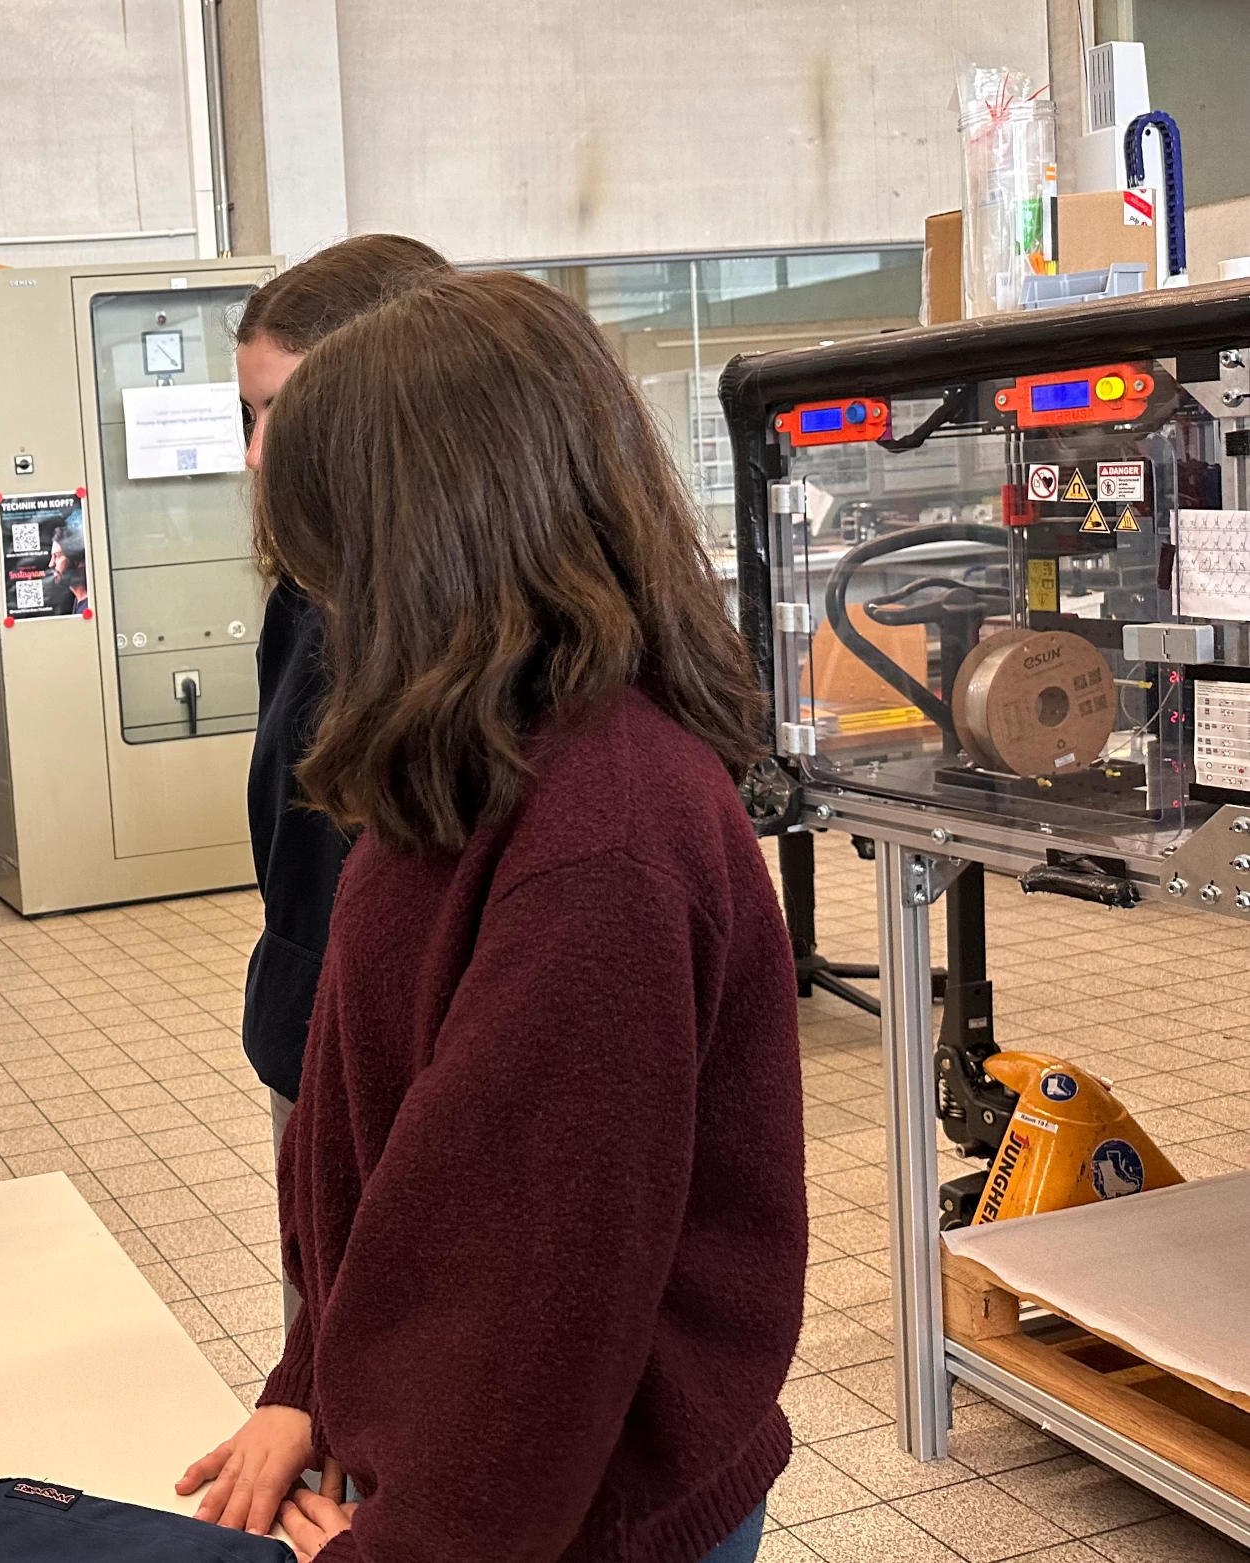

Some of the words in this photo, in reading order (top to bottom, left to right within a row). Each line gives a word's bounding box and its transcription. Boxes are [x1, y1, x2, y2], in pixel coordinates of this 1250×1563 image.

[1056, 409, 1095, 420] PRUSA
[1109, 466, 1139, 475] DANGER
[1, 501, 37, 511] TECHNIK
[38, 500, 48, 509] IM
[49, 498, 74, 507] KOPF?
[8, 570, 46, 580] Instagram
[979, 1130, 1023, 1225] JUNGHEI
